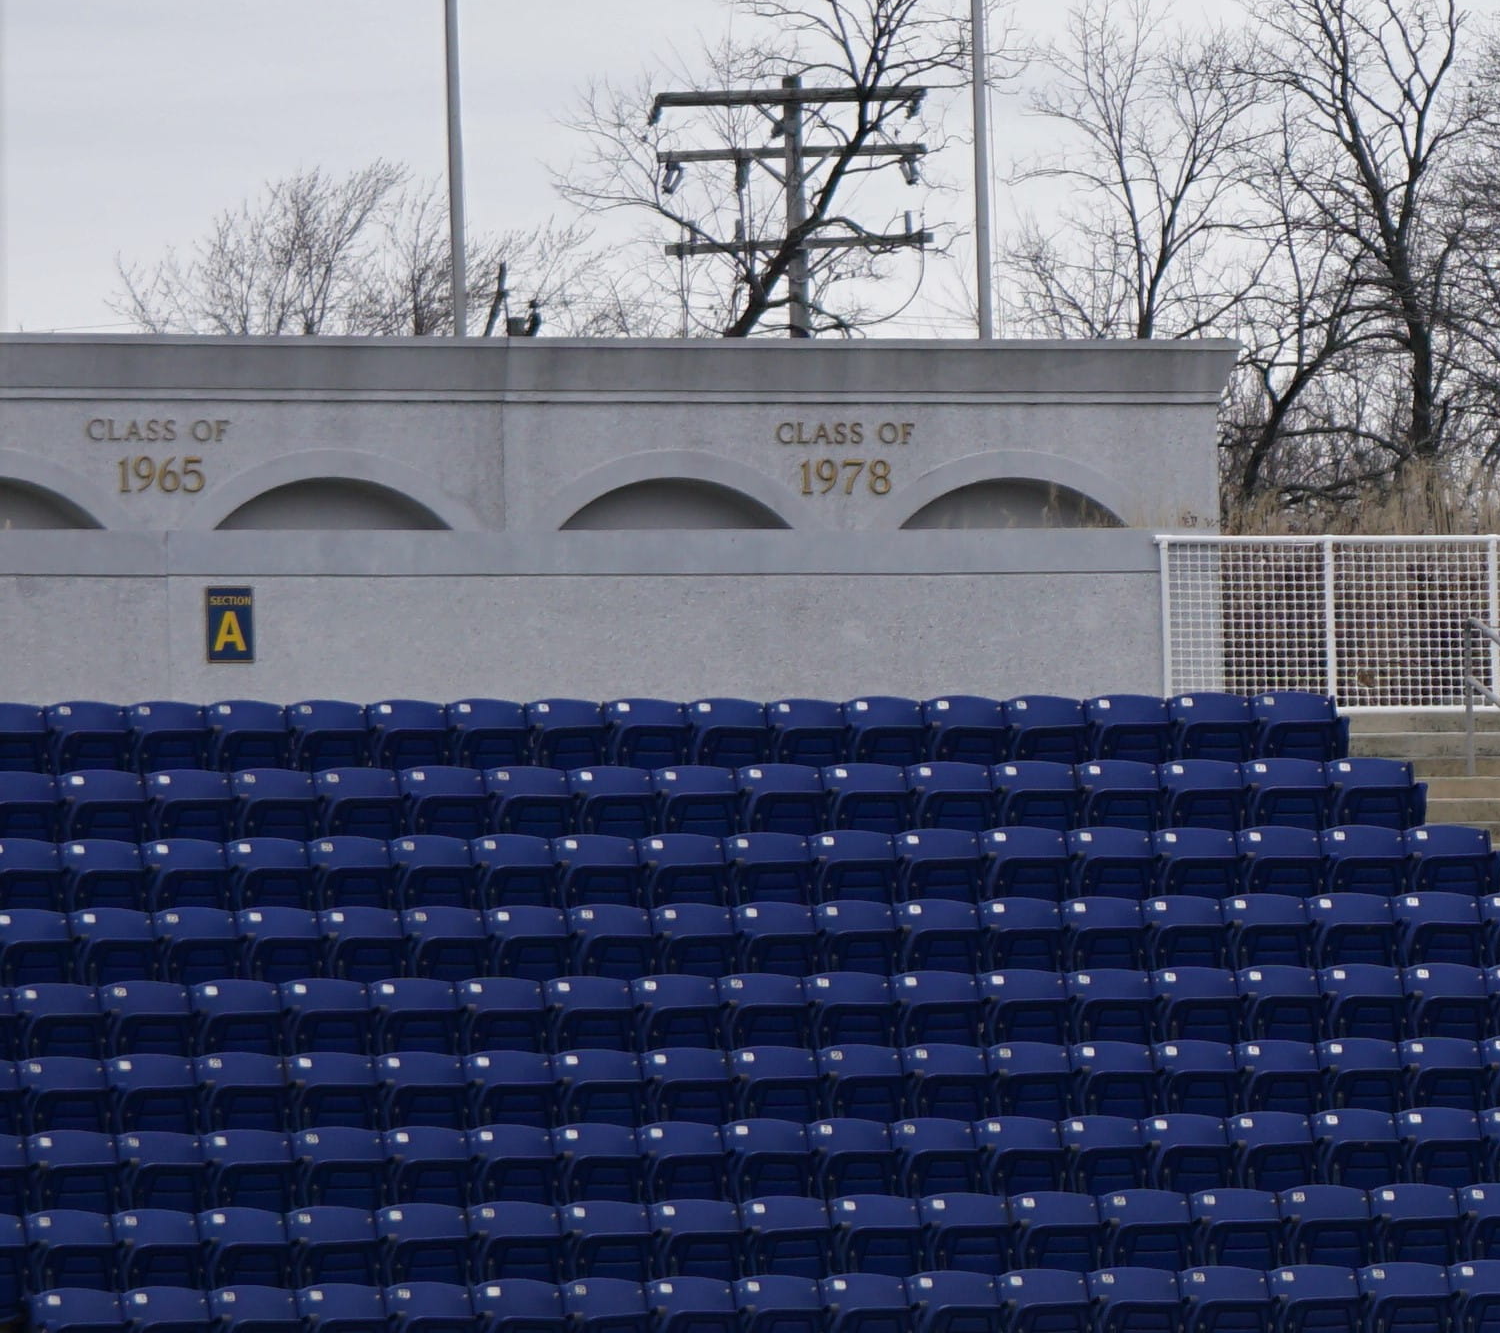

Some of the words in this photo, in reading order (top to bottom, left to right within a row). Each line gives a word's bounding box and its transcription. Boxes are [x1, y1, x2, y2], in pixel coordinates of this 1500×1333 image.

[86, 418, 177, 442] CLASS
[191, 419, 232, 442] OF
[776, 422, 864, 445] CLASS
[878, 422, 915, 445] OF
[117, 455, 206, 493] 1965
[800, 458, 892, 495] 1978
[209, 595, 252, 606] SECTION
[214, 610, 248, 652] A
